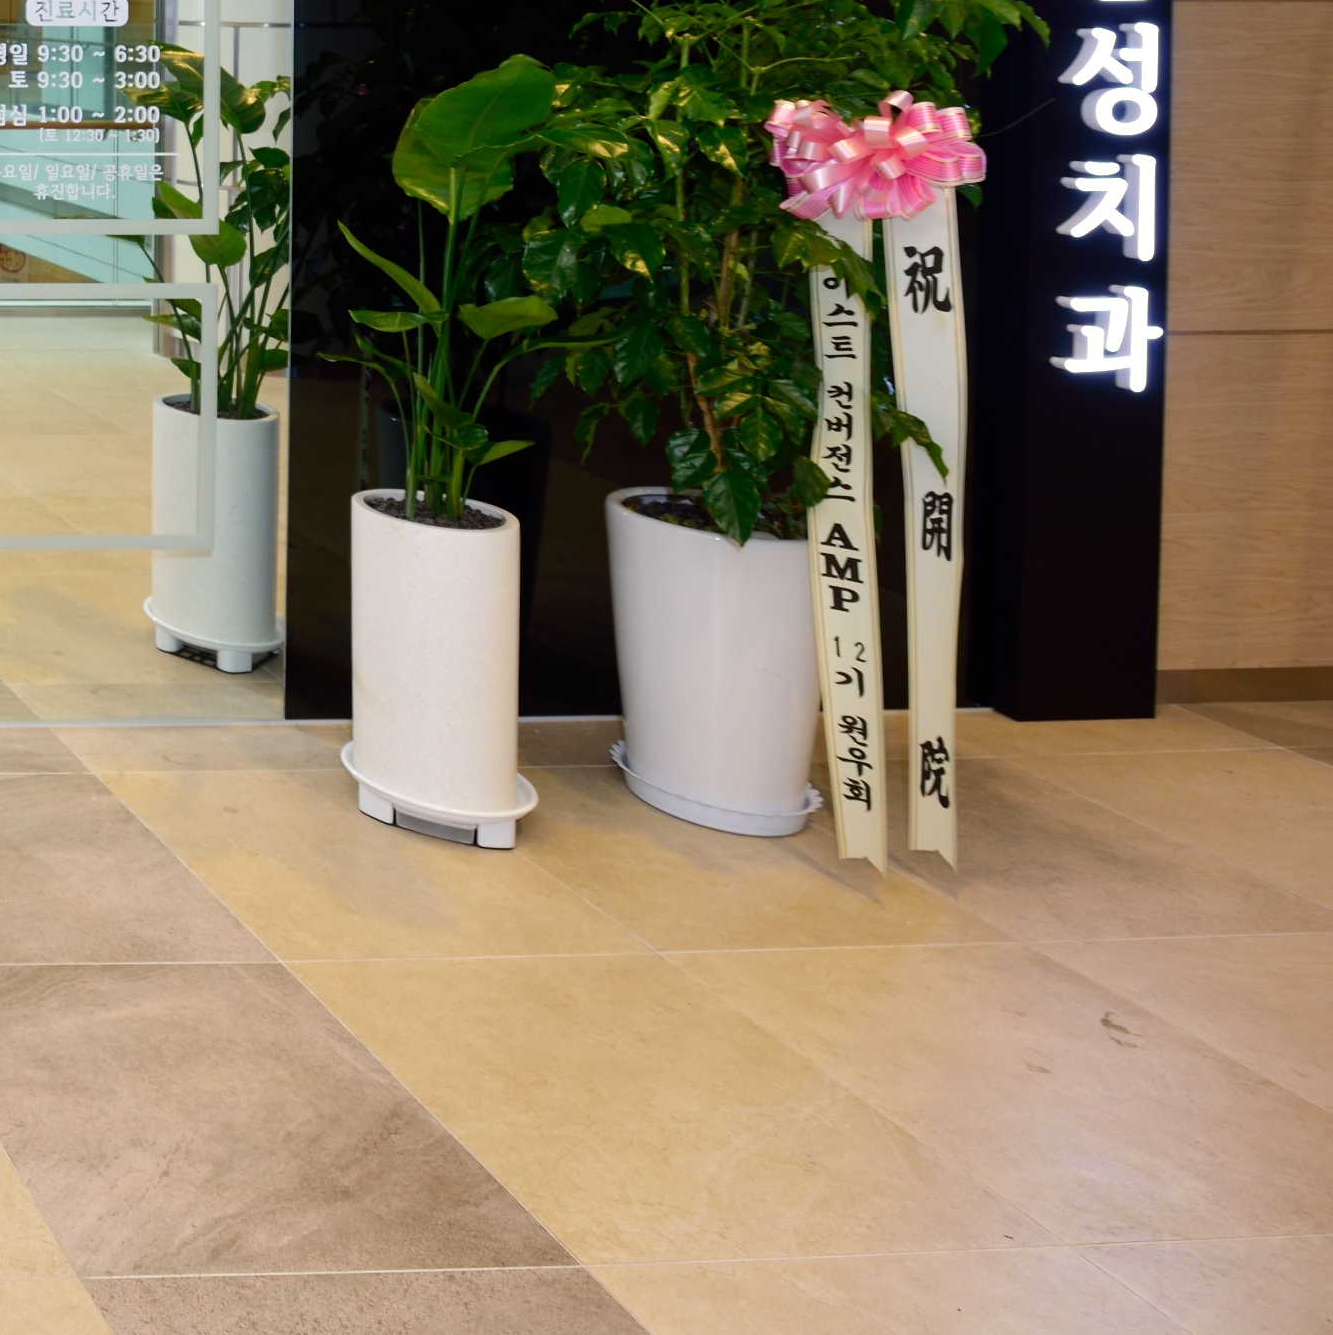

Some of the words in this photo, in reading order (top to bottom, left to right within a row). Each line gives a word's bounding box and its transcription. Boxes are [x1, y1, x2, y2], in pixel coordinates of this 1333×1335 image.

[35, 0, 120, 22] 진료시간
[37, 45, 84, 63] 9:30
[114, 45, 161, 63] 6:30
[8, 70, 29, 89] 토
[37, 71, 83, 89] 9:30
[114, 71, 161, 89] 3:00
[38, 106, 83, 123] 1:00
[114, 106, 161, 123] 2:00
[39, 128, 59, 143] (토
[65, 129, 104, 142] 12:30
[124, 128, 161, 143] 1:30)
[45, 164, 96, 181] 일요일/
[102, 164, 164, 181] 공휴일은
[34, 183, 116, 200] 휴진합니다.
[822, 382, 856, 503] 컨버전스
[820, 523, 864, 613] AMP
[836, 714, 873, 812] 원우회
